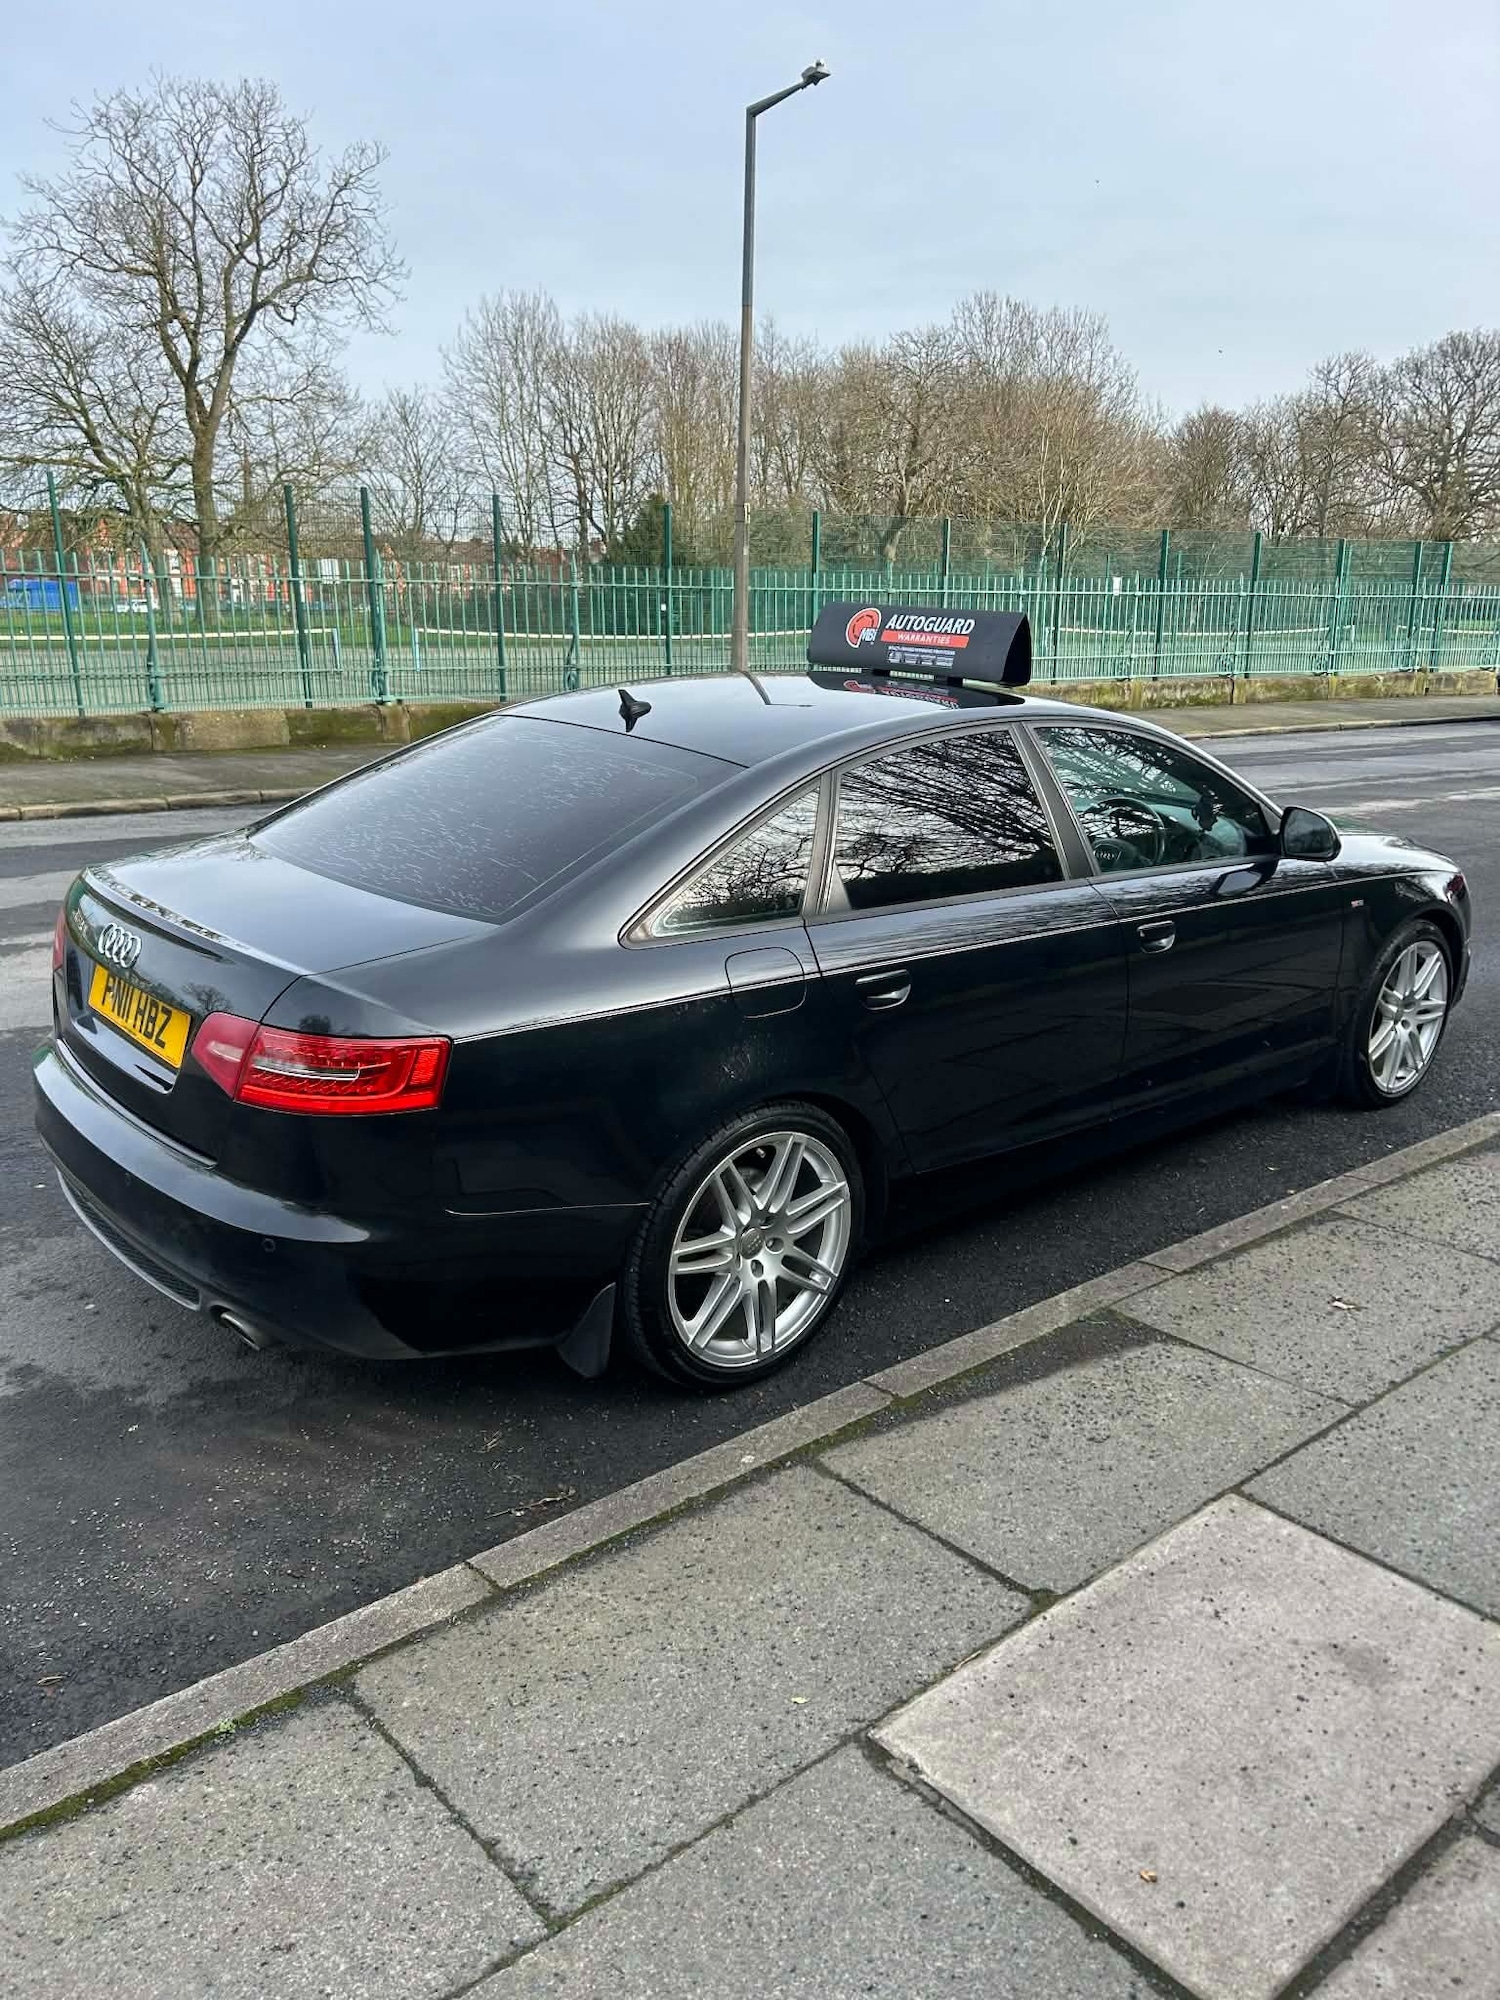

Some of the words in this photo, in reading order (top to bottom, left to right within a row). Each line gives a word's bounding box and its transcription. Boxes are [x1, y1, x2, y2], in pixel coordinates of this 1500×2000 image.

[886, 614, 975, 634] AUTOGUARD
[897, 633, 951, 645] WARRANTIES
[133, 991, 173, 1050] HBZ
